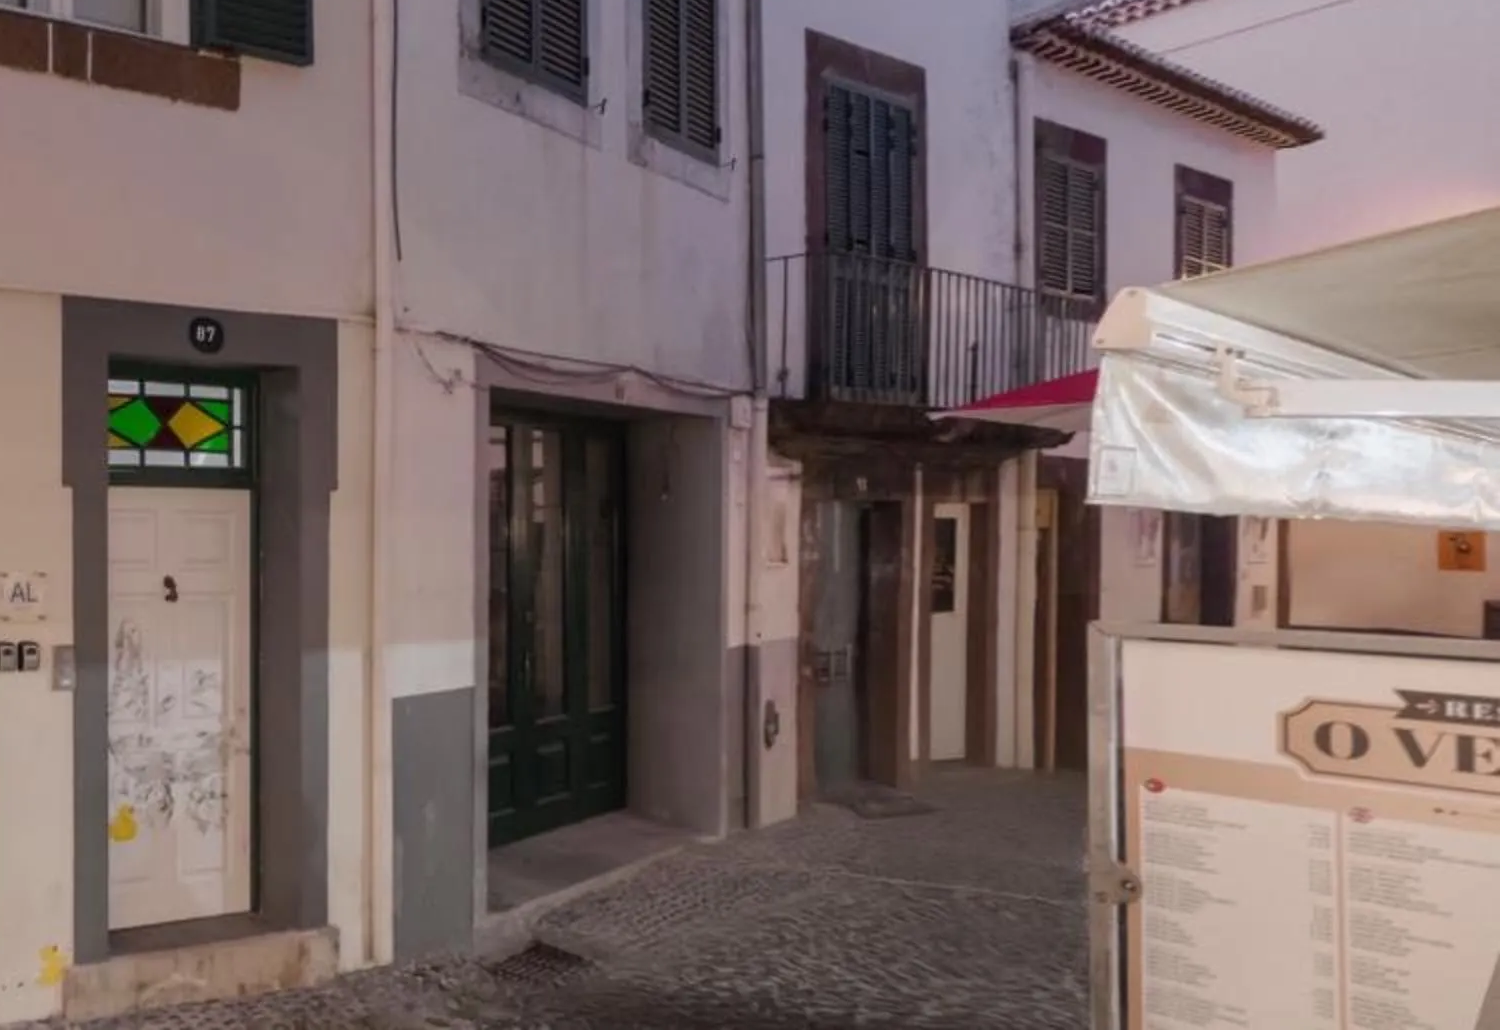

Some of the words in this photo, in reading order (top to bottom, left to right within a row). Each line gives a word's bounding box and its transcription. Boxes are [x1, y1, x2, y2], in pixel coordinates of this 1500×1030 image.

[196, 325, 215, 342] 87
[10, 581, 39, 603] AL
[1444, 700, 1500, 724] RE
[1313, 721, 1370, 760] O
